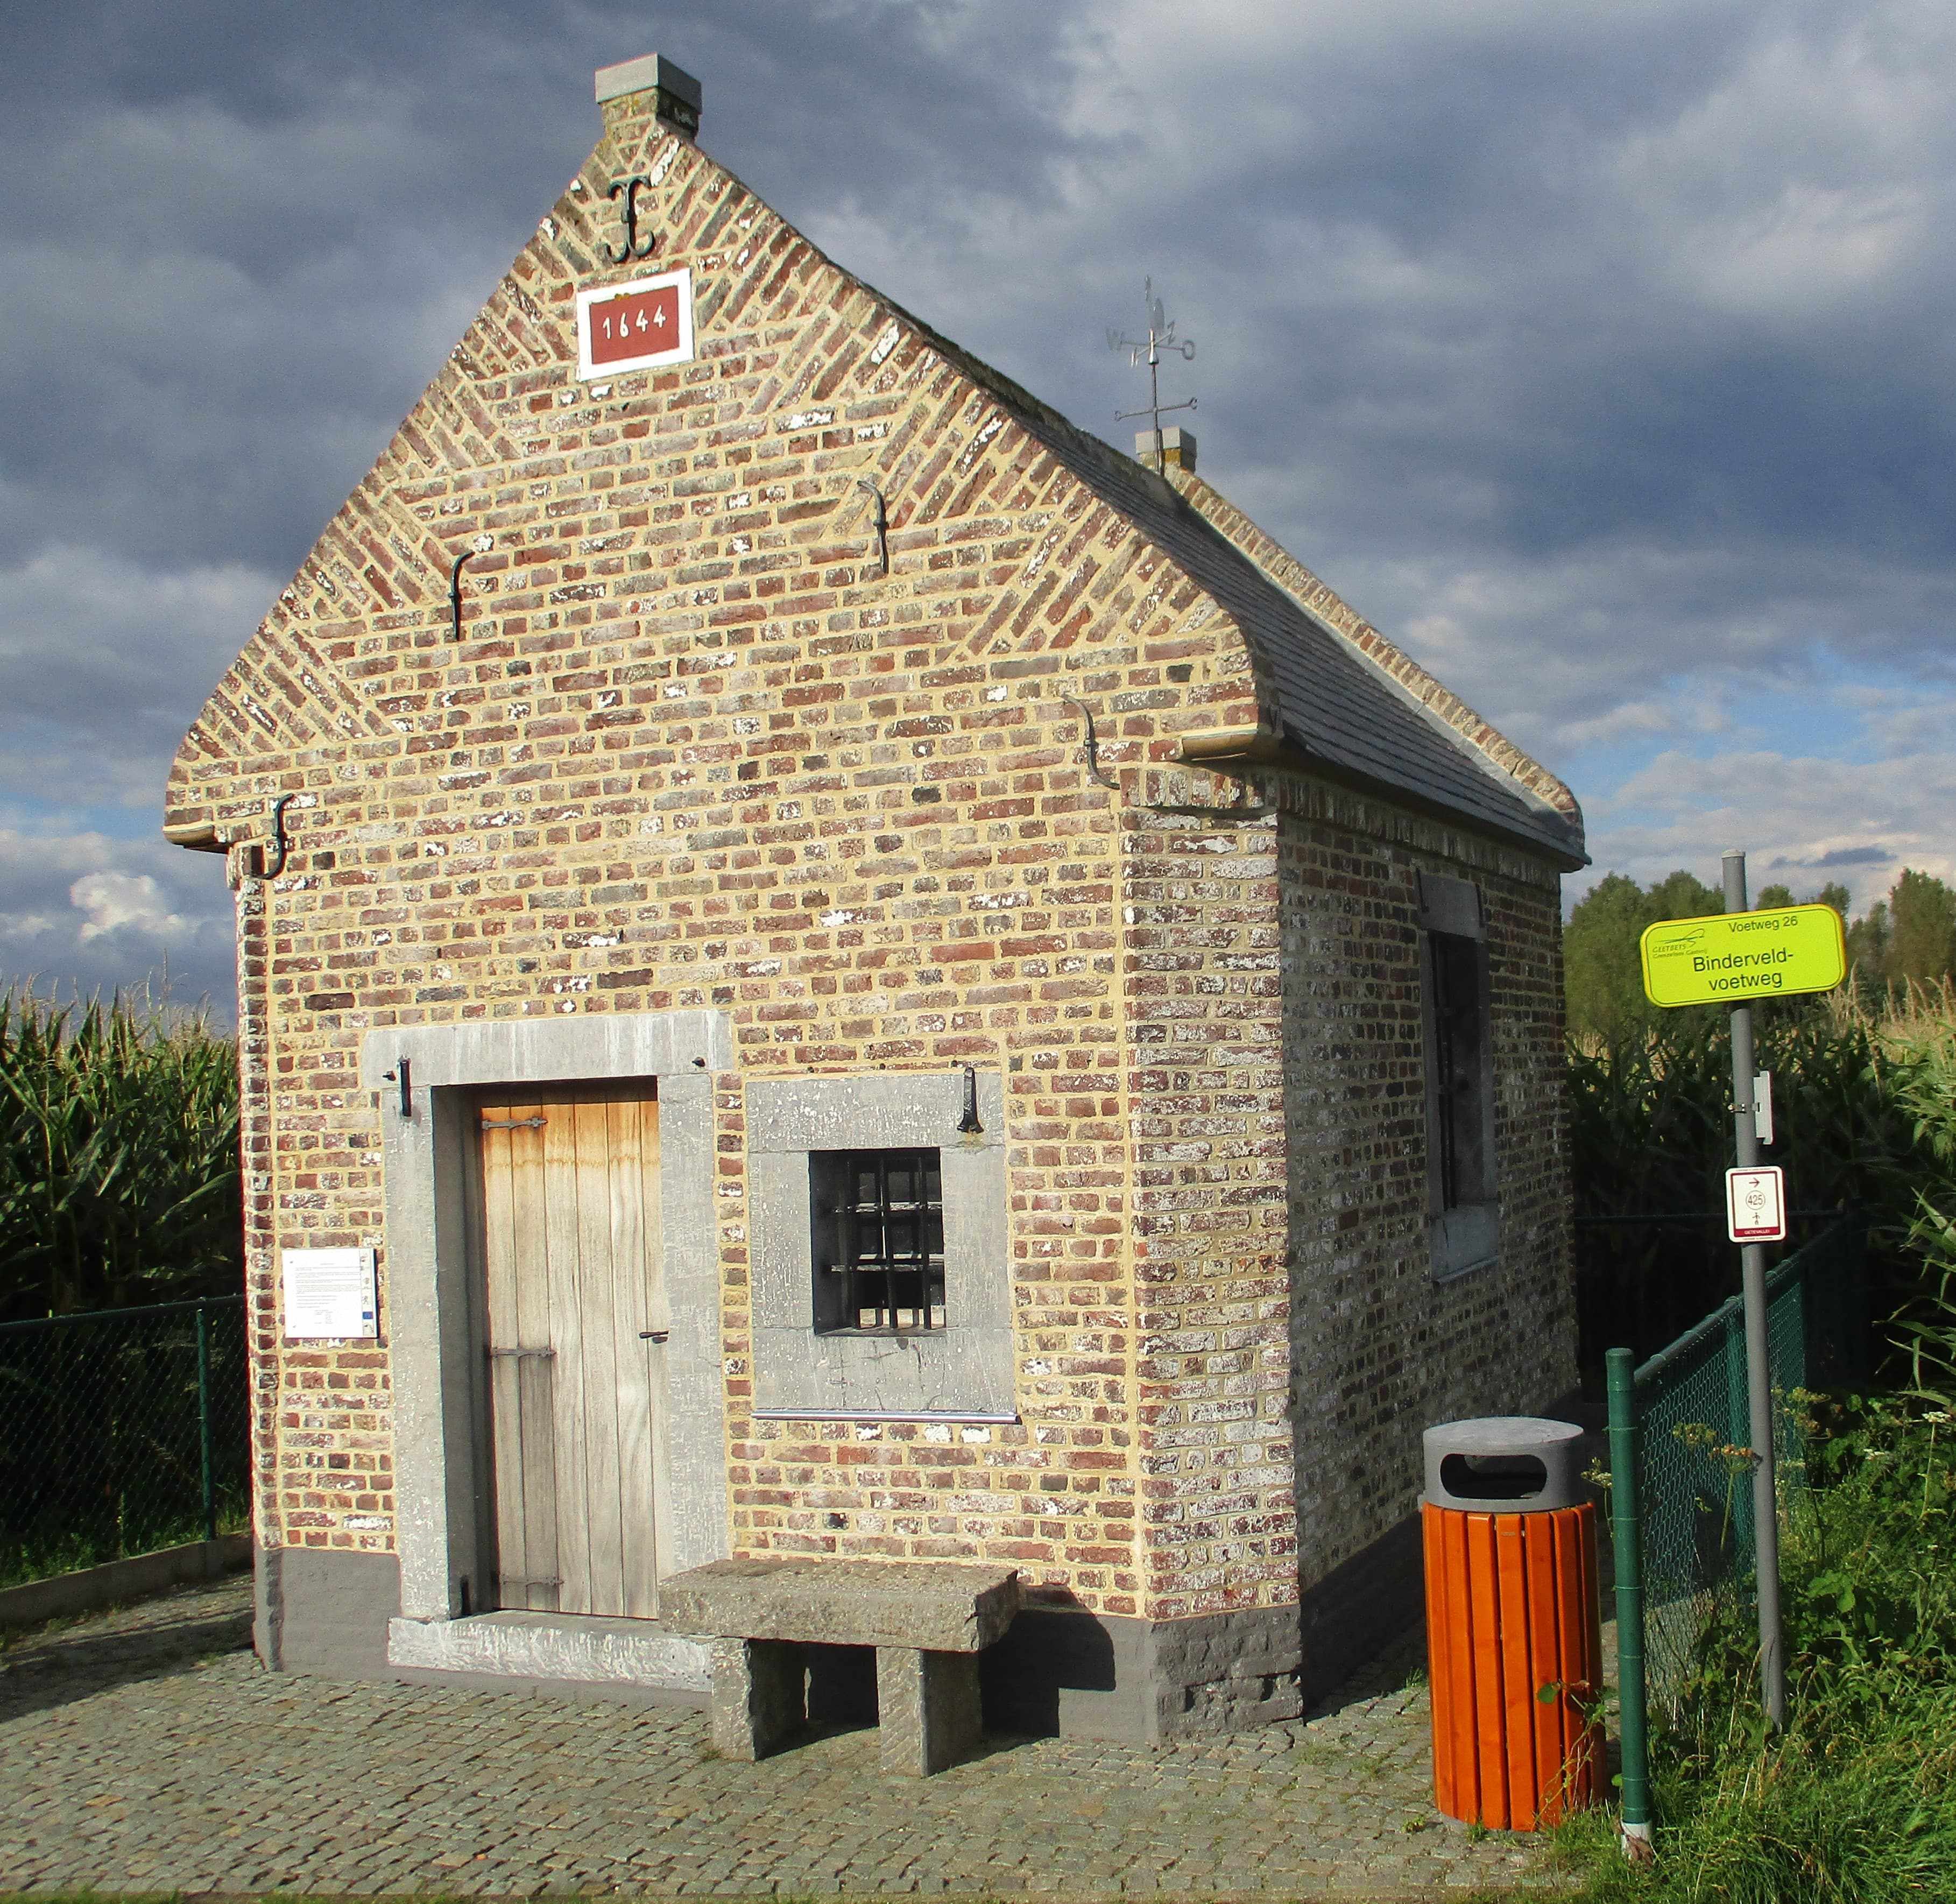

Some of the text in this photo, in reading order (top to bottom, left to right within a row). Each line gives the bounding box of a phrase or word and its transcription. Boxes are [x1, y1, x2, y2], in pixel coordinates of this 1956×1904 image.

[602, 304, 667, 340] 1644
[1728, 916, 1798, 933] Voetweg 26
[1693, 947, 1793, 972] Binderveld-
[1708, 972, 1782, 991] voetweg
[1748, 1195, 1763, 1205] 425
